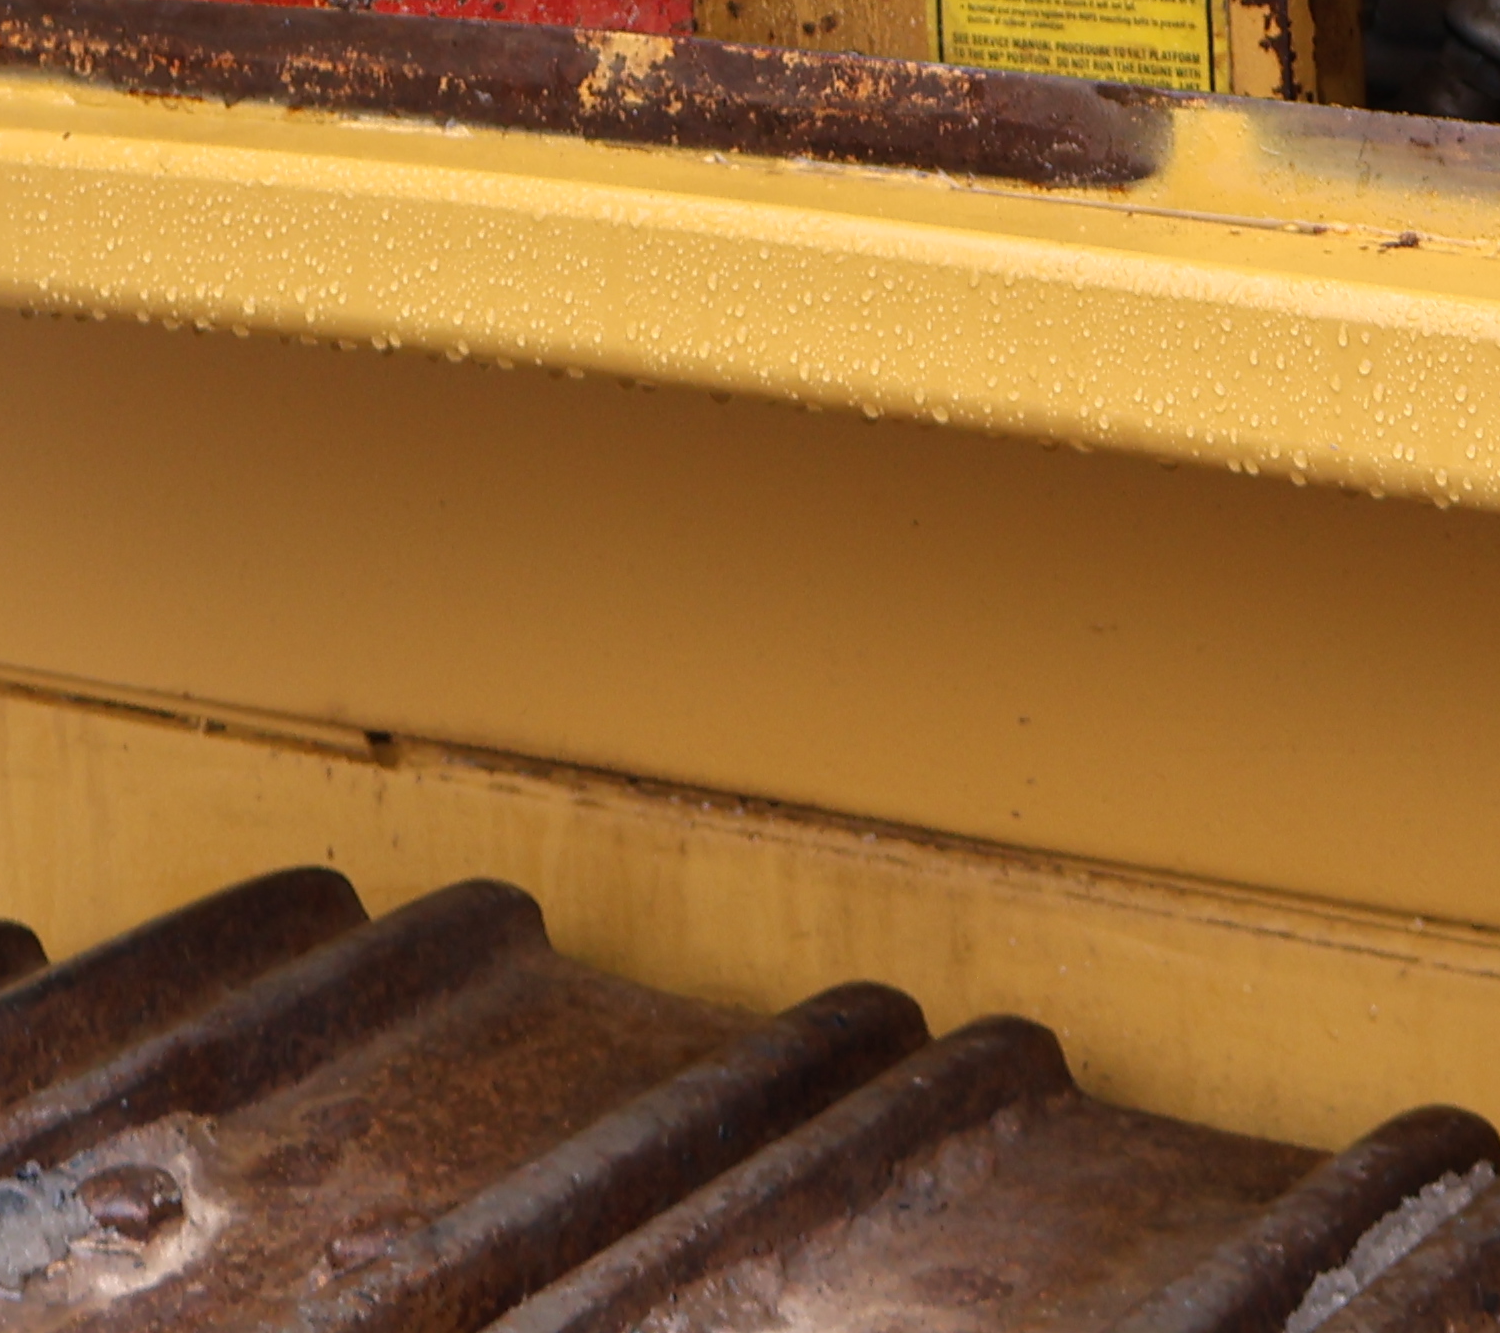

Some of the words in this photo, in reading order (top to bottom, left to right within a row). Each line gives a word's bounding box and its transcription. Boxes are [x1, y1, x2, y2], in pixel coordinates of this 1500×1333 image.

[953, 32, 968, 45] SEE
[972, 33, 1008, 47] SERVICE
[1013, 37, 1051, 50] MANUAL
[1056, 40, 1109, 55] PROCEDURE
[1114, 46, 1126, 58] TO
[1149, 48, 1200, 64] PLATFORM
[954, 46, 965, 58] TO
[969, 47, 985, 60] THE
[1057, 55, 1069, 68] DO
[1072, 57, 1090, 69] NOT
[1094, 60, 1114, 72] RUN
[1117, 61, 1134, 73] THE
[1138, 63, 1172, 76] ENGINE
[1176, 66, 1201, 78] WITH
